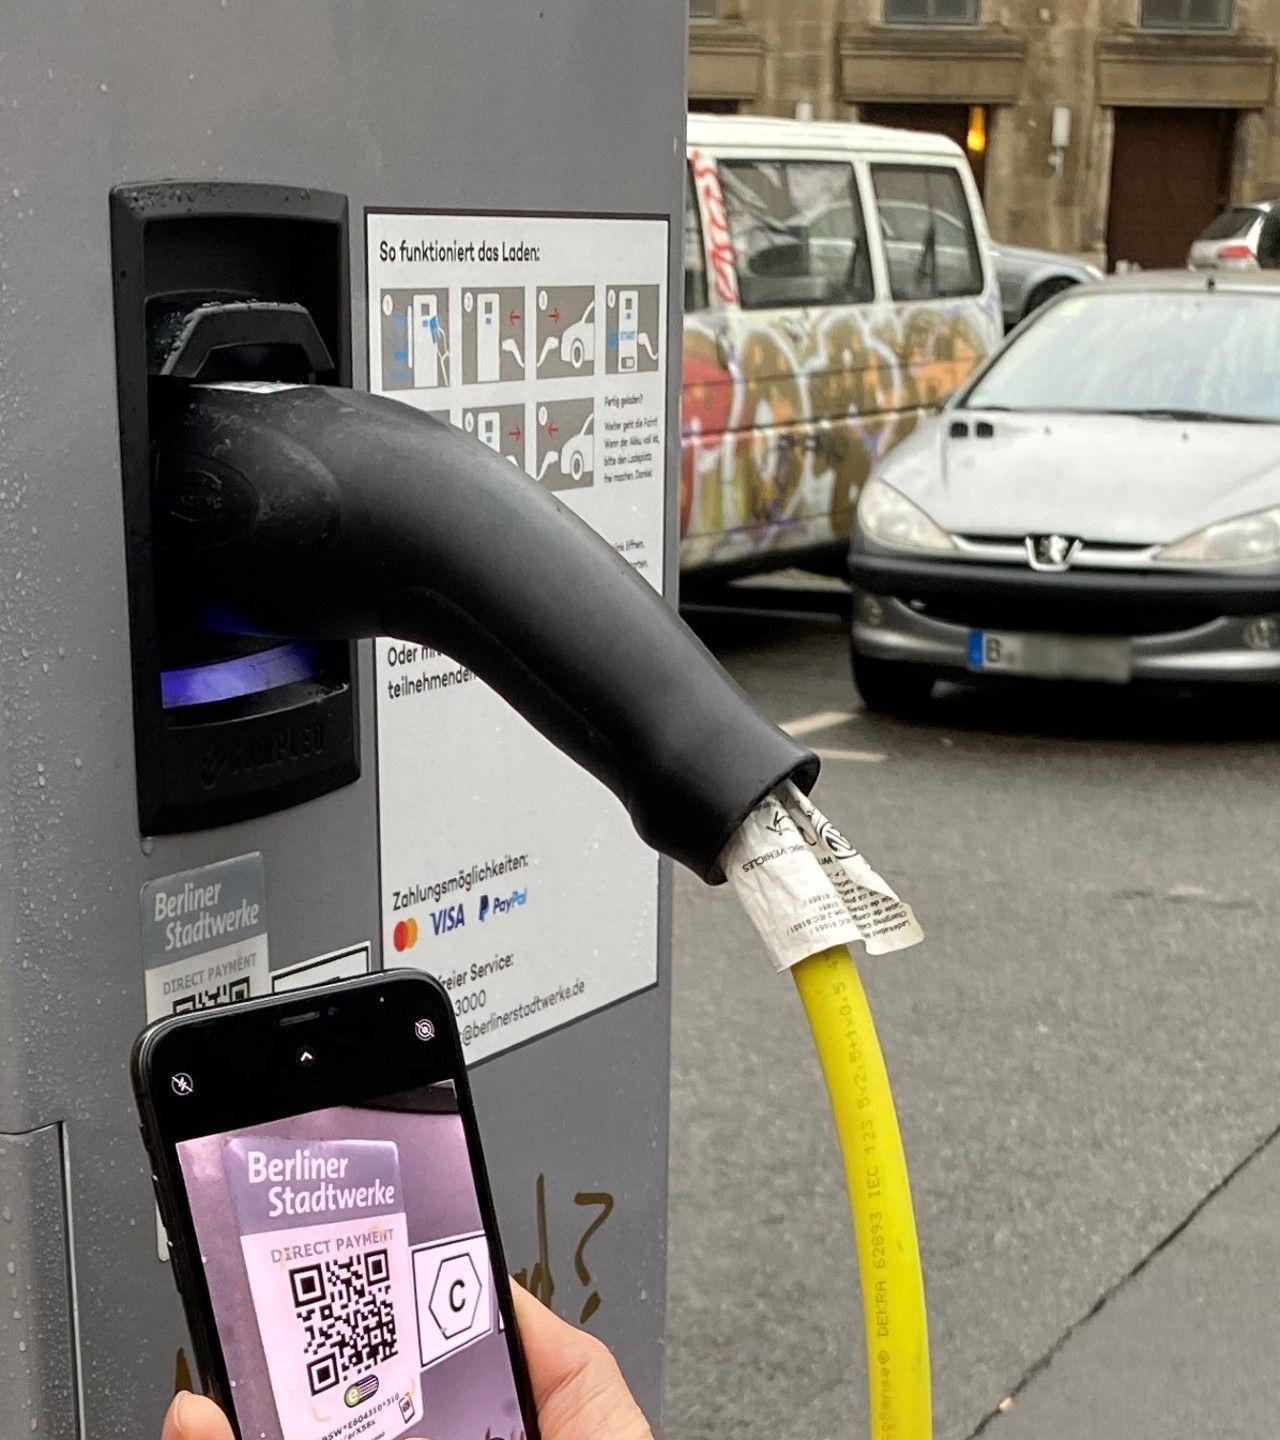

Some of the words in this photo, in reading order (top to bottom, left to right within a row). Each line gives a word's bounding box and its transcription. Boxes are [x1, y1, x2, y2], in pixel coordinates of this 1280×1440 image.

[379, 240, 396, 262] So
[399, 240, 475, 262] funktioniert
[478, 241, 499, 262] das
[502, 241, 540, 262] Laden:
[387, 644, 418, 667] Oder
[392, 853, 529, 912] Zahlungsmöglichkeiten:
[154, 883, 222, 922] Berliner
[429, 903, 465, 936] VISA
[493, 888, 528, 914] PayPal
[165, 899, 259, 951] Stadtwerke
[163, 970, 205, 996] DIRECT
[208, 953, 257, 979] PAYMENT
[437, 969, 468, 991] freier
[470, 953, 514, 981] Service:
[458, 977, 586, 1046] @berlinerstadtwerke.de
[248, 1149, 349, 1184] Berliner
[868, 1164, 881, 1199] IEC
[269, 1179, 395, 1217] Stadtwerke
[271, 1240, 330, 1263] DIRECT
[336, 1229, 394, 1250] PAYMENT
[449, 1278, 466, 1312] C
[875, 1280, 889, 1337] DEKRA
